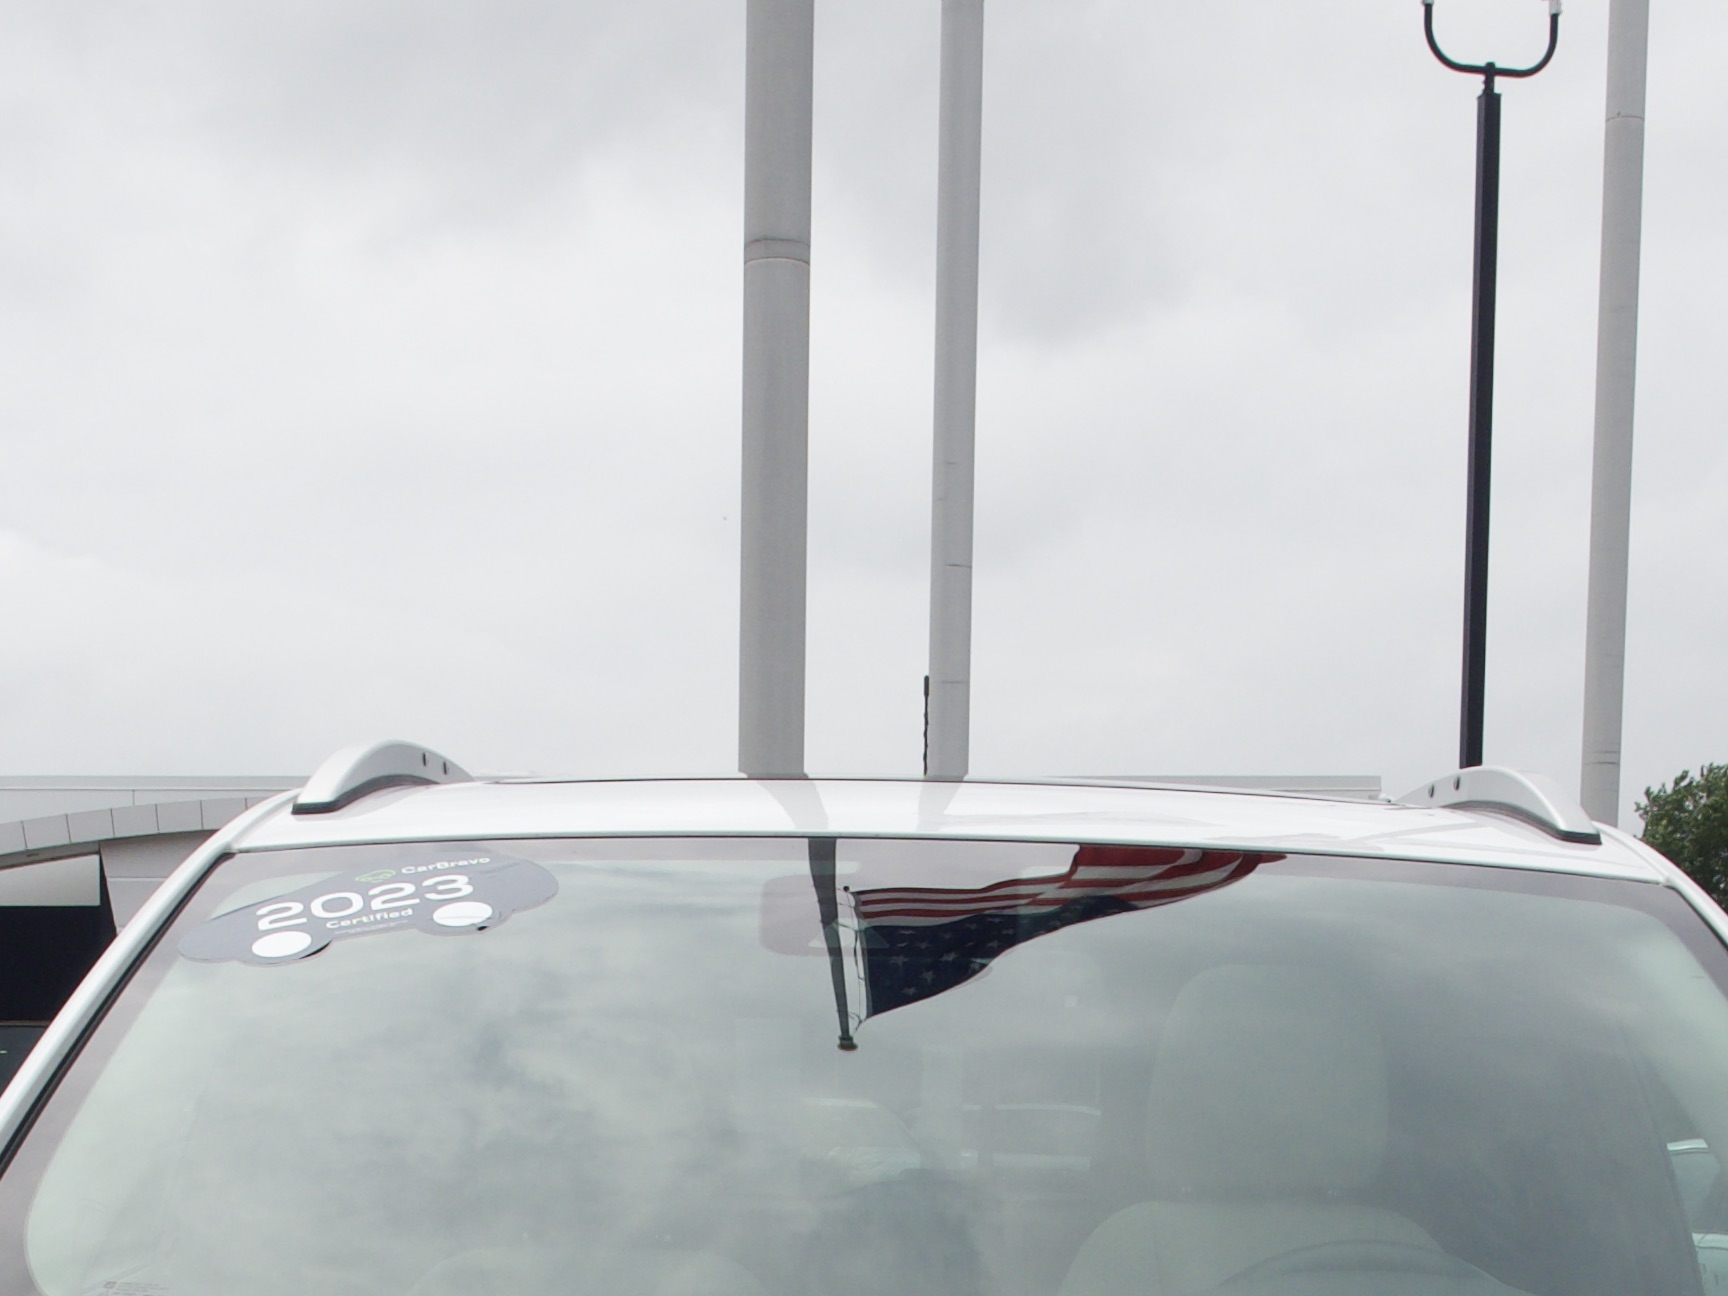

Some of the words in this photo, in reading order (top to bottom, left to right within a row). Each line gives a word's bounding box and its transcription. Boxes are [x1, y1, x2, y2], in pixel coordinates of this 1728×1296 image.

[401, 857, 491, 875] CarBravo
[256, 874, 474, 931] 2023
[325, 908, 413, 929] Certified
